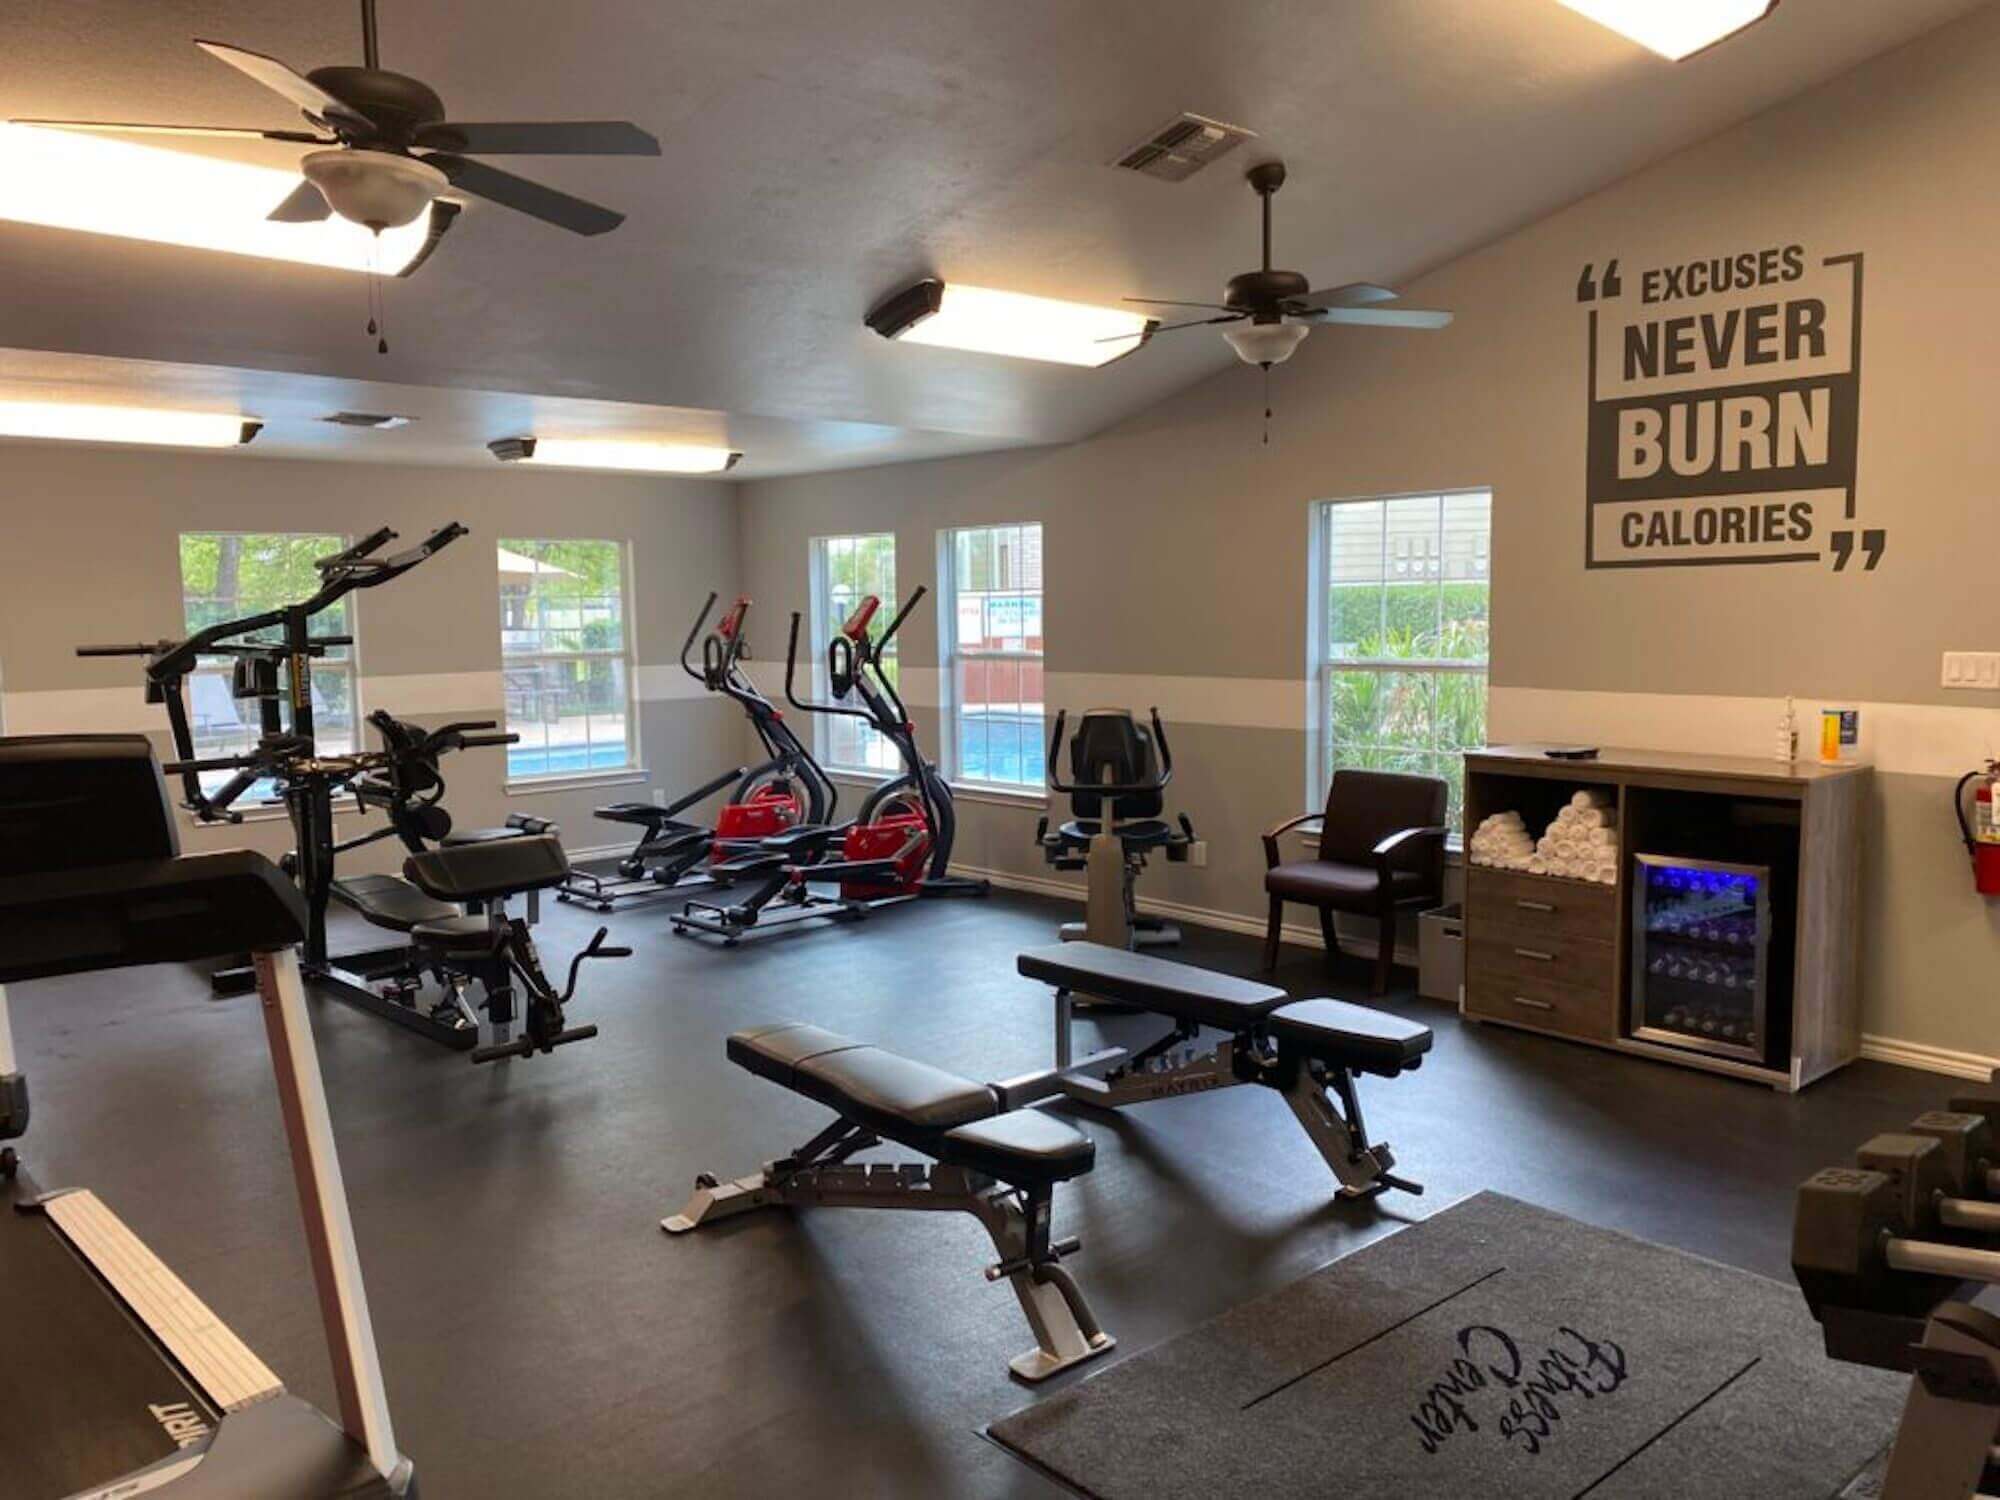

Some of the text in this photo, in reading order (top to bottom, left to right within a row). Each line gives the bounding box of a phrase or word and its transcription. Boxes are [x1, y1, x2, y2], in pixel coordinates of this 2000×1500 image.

[1641, 244, 1804, 304] EXCUSES
[1623, 298, 1827, 382] NEVER
[1617, 387, 1831, 480] BURN
[1620, 502, 1814, 548] CALORIES
[1410, 1325, 1522, 1454] Center
[1500, 1326, 1629, 1454] Fitness
